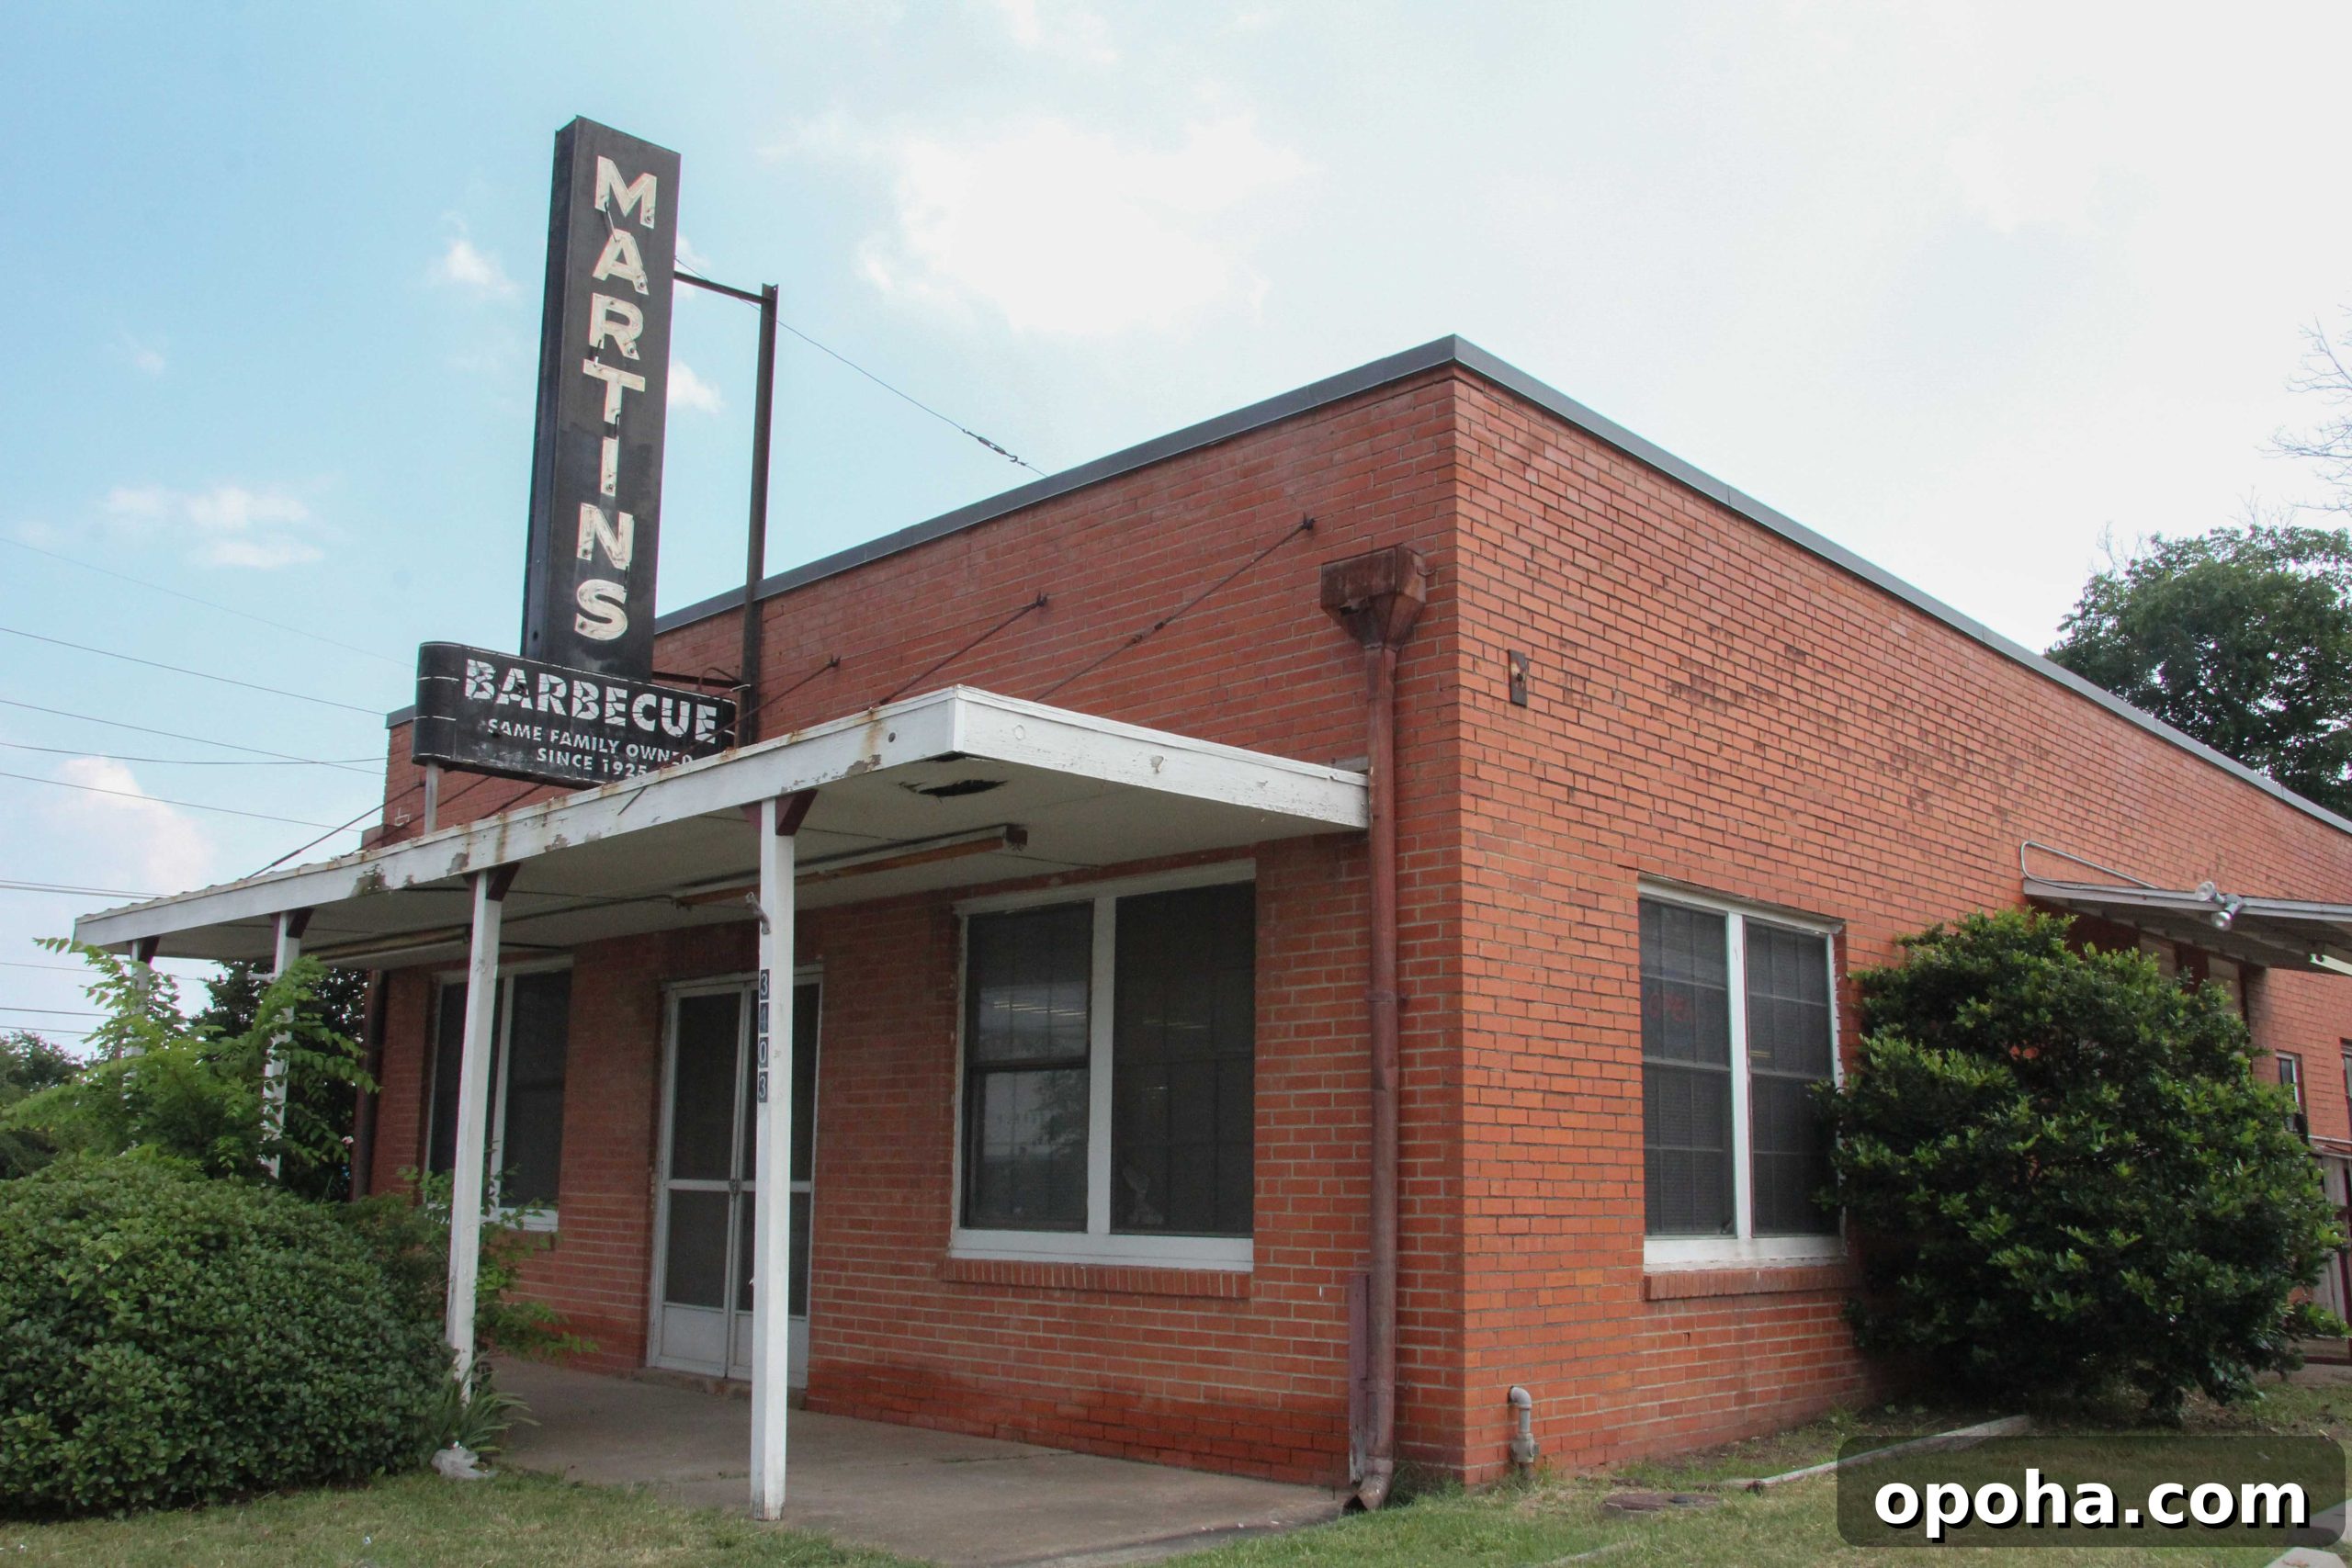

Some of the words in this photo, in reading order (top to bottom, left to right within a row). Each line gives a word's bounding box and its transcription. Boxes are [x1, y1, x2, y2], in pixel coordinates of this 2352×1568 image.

[574, 155, 658, 640] MARTINS
[465, 659, 718, 744] BARBECUE
[487, 718, 542, 741] SAME
[550, 729, 621, 754] FAMILY
[537, 748, 593, 770] SINCE
[603, 759, 648, 777] 1925
